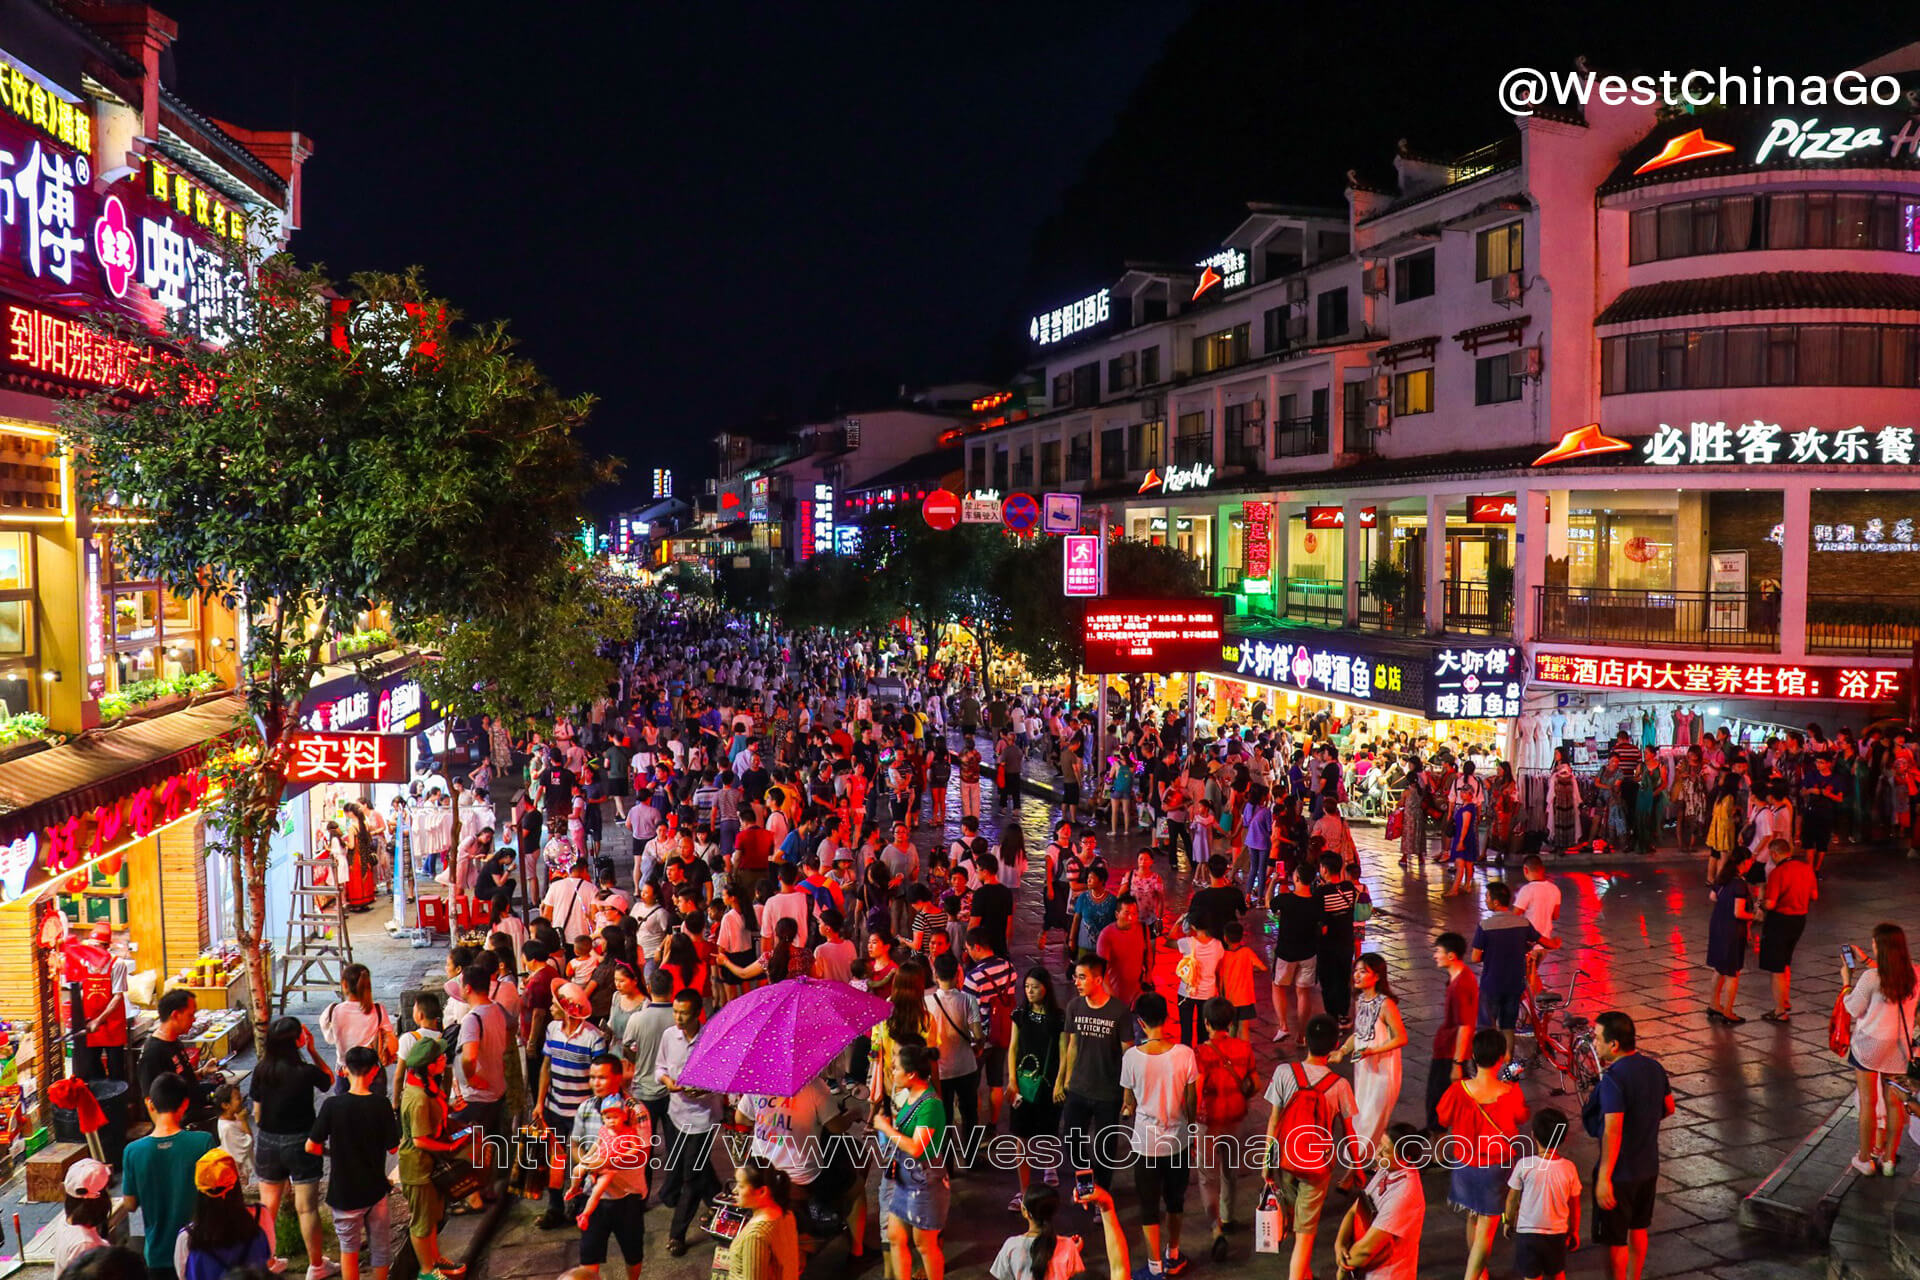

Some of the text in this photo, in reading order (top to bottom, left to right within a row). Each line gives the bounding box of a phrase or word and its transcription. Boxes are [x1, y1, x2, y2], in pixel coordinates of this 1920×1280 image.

[1755, 118, 1920, 164] Pizza H
[1162, 462, 1215, 494] Pizza Hut
[964, 501, 999, 510] 禁止一切
[964, 511, 999, 520] 车辆驶入
[1237, 638, 1402, 698] 大师傅 啤酒鱼 总店
[1435, 648, 1509, 676] 大师傅
[1436, 692, 1504, 719] 啤酒鱼
[1504, 682, 1520, 717] 总店
[281, 735, 387, 780] 实料
[1074, 1016, 1115, 1028] ABERCROMBIE
[1083, 1024, 1101, 1033] FITCH
